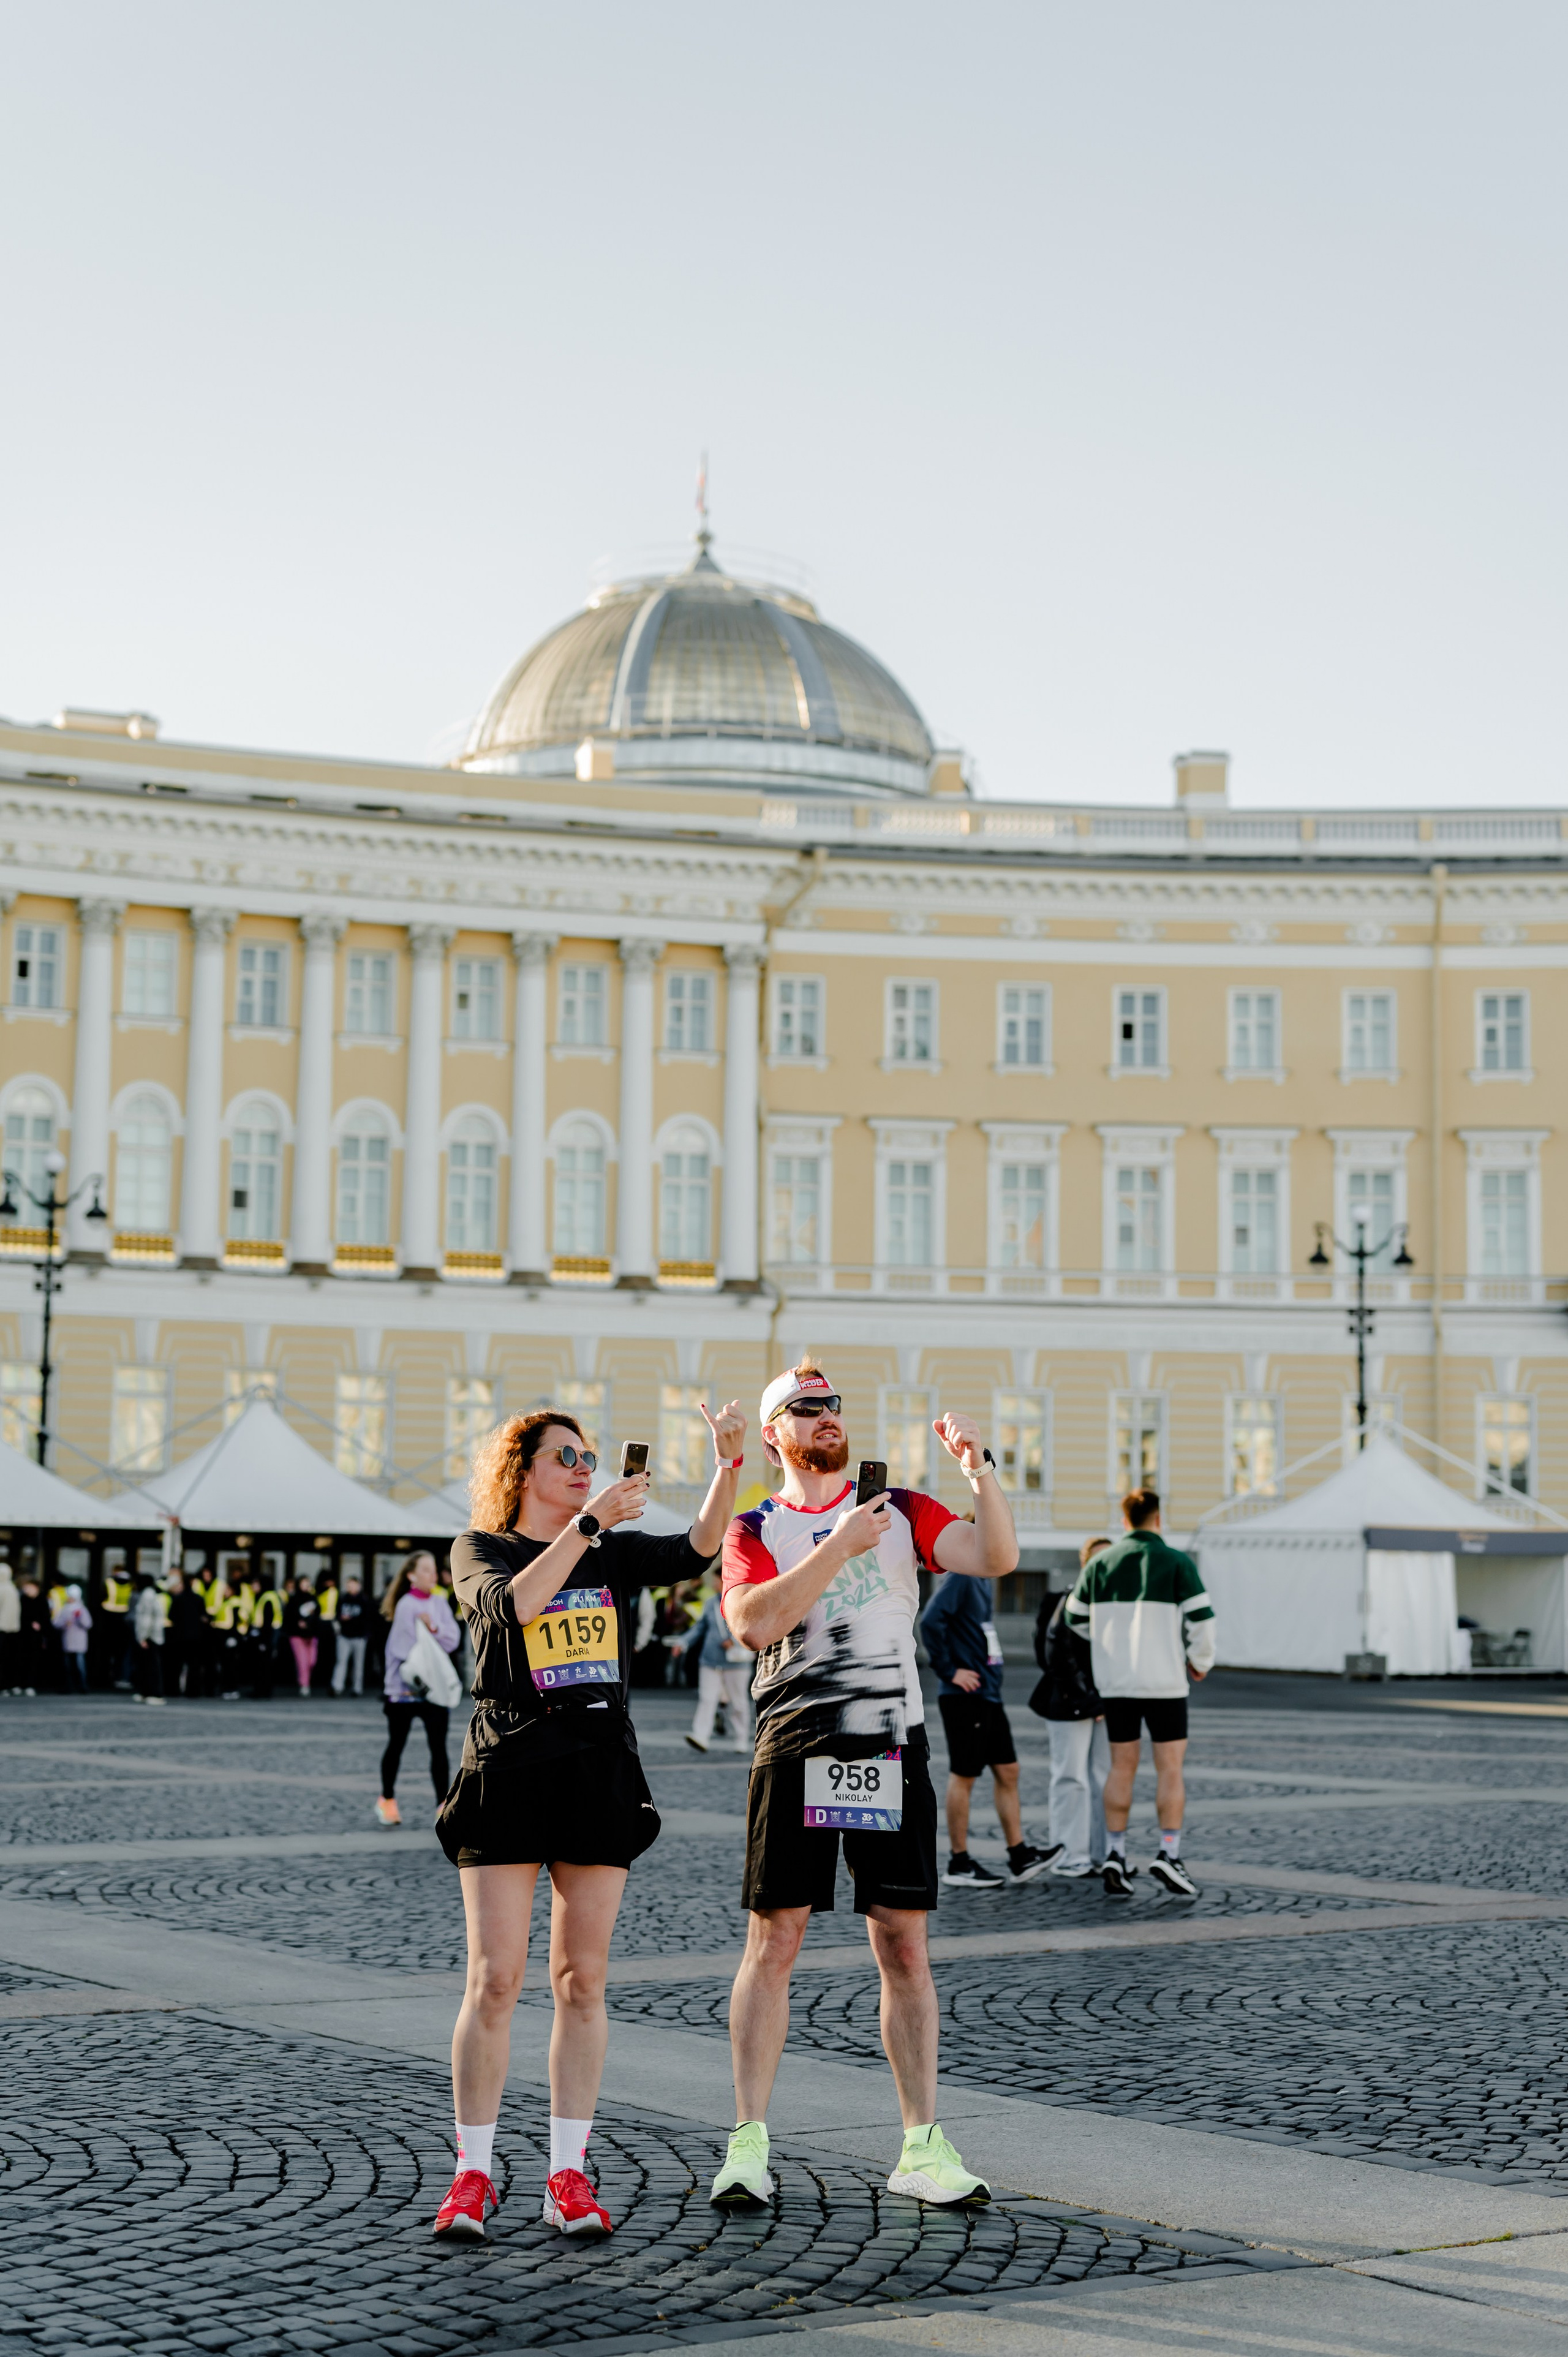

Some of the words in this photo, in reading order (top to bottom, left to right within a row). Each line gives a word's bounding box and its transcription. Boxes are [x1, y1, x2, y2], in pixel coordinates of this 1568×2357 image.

[601, 1598, 614, 1607] 24
[825, 1576, 889, 1621] 2024
[539, 1615, 606, 1650] 1159
[543, 1670, 556, 1686] D
[827, 1763, 881, 1792] 958
[835, 1793, 873, 1803] NIKOLAY
[815, 1809, 827, 1823] D
